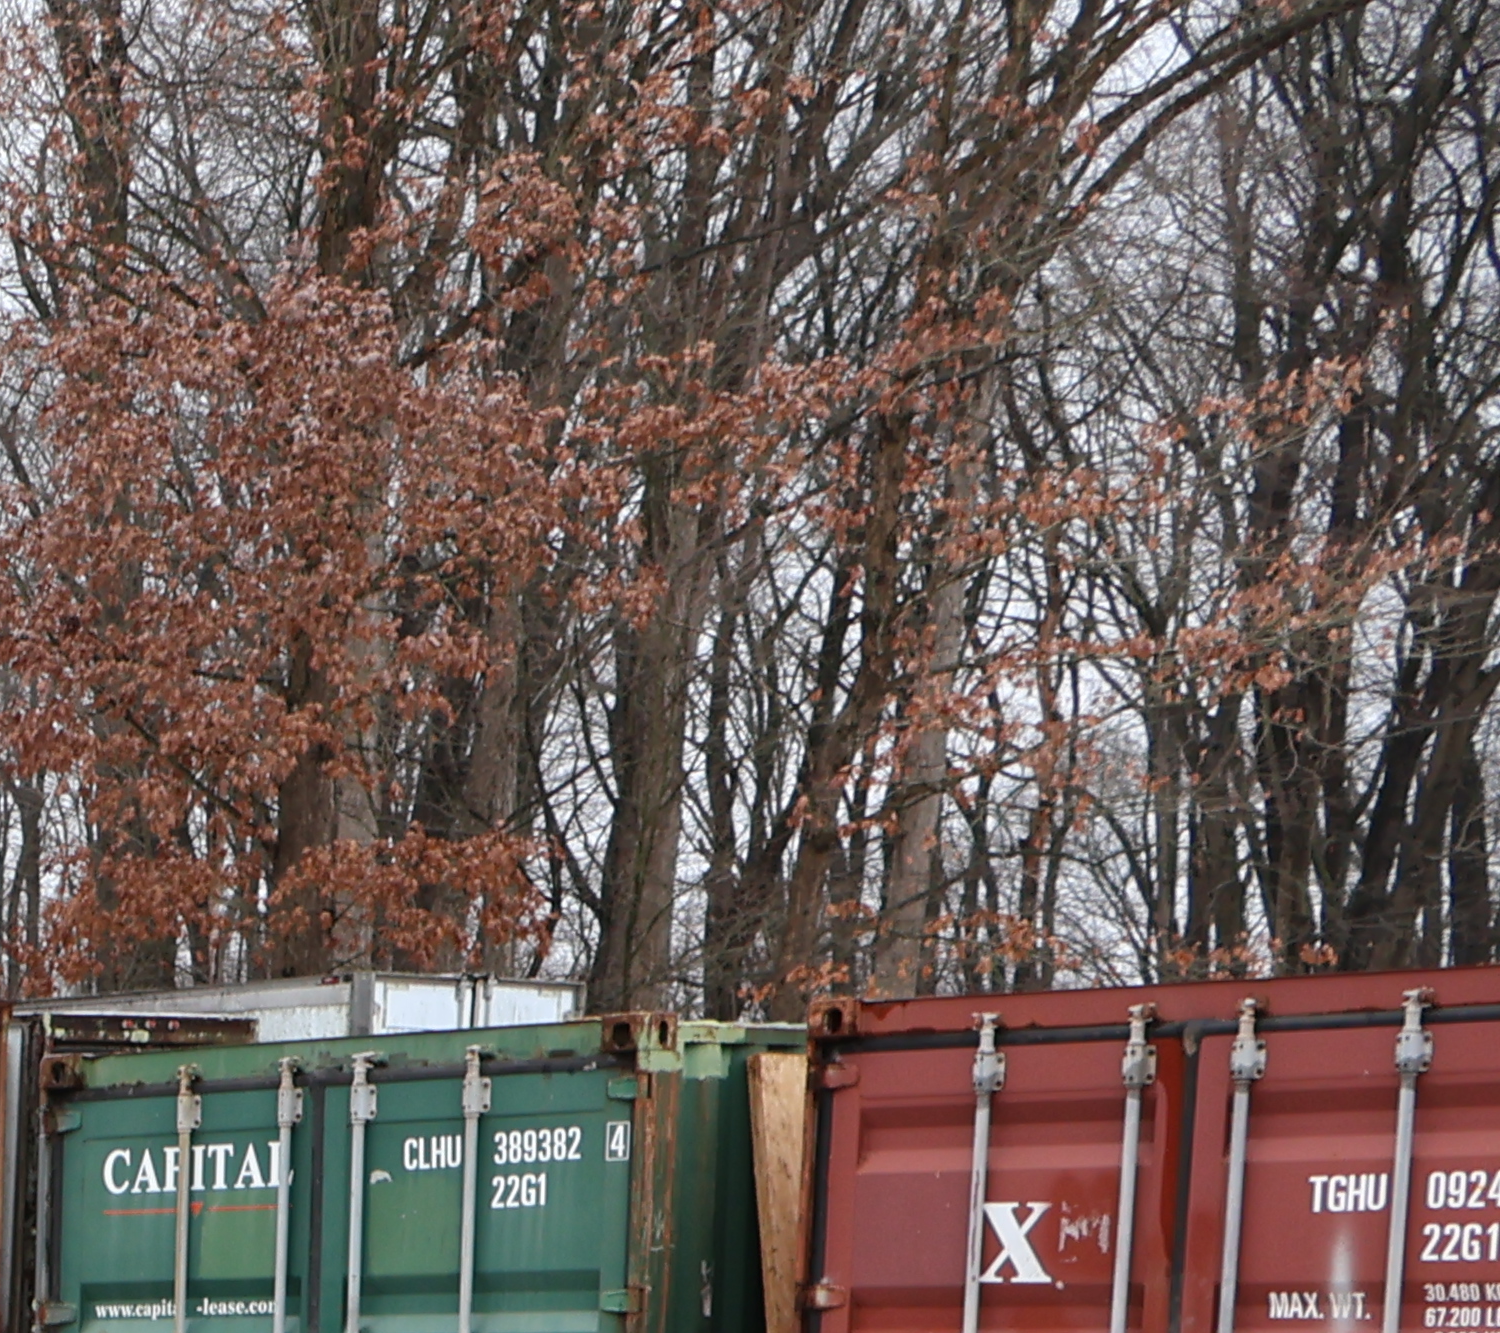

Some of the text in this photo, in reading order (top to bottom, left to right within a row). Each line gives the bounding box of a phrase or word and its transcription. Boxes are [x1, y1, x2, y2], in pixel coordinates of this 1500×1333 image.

[403, 1135, 462, 1170] CLHU
[493, 1126, 582, 1164] 389382
[490, 1172, 547, 1209] 22G1
[1308, 1173, 1389, 1213] TGHU
[1421, 1222, 1500, 1262] 22G1
[1268, 1292, 1324, 1320] MAX.
[1329, 1292, 1371, 1320] WT.
[1423, 1283, 1480, 1302] 30.480
[1424, 1306, 1481, 1328] 67.200
